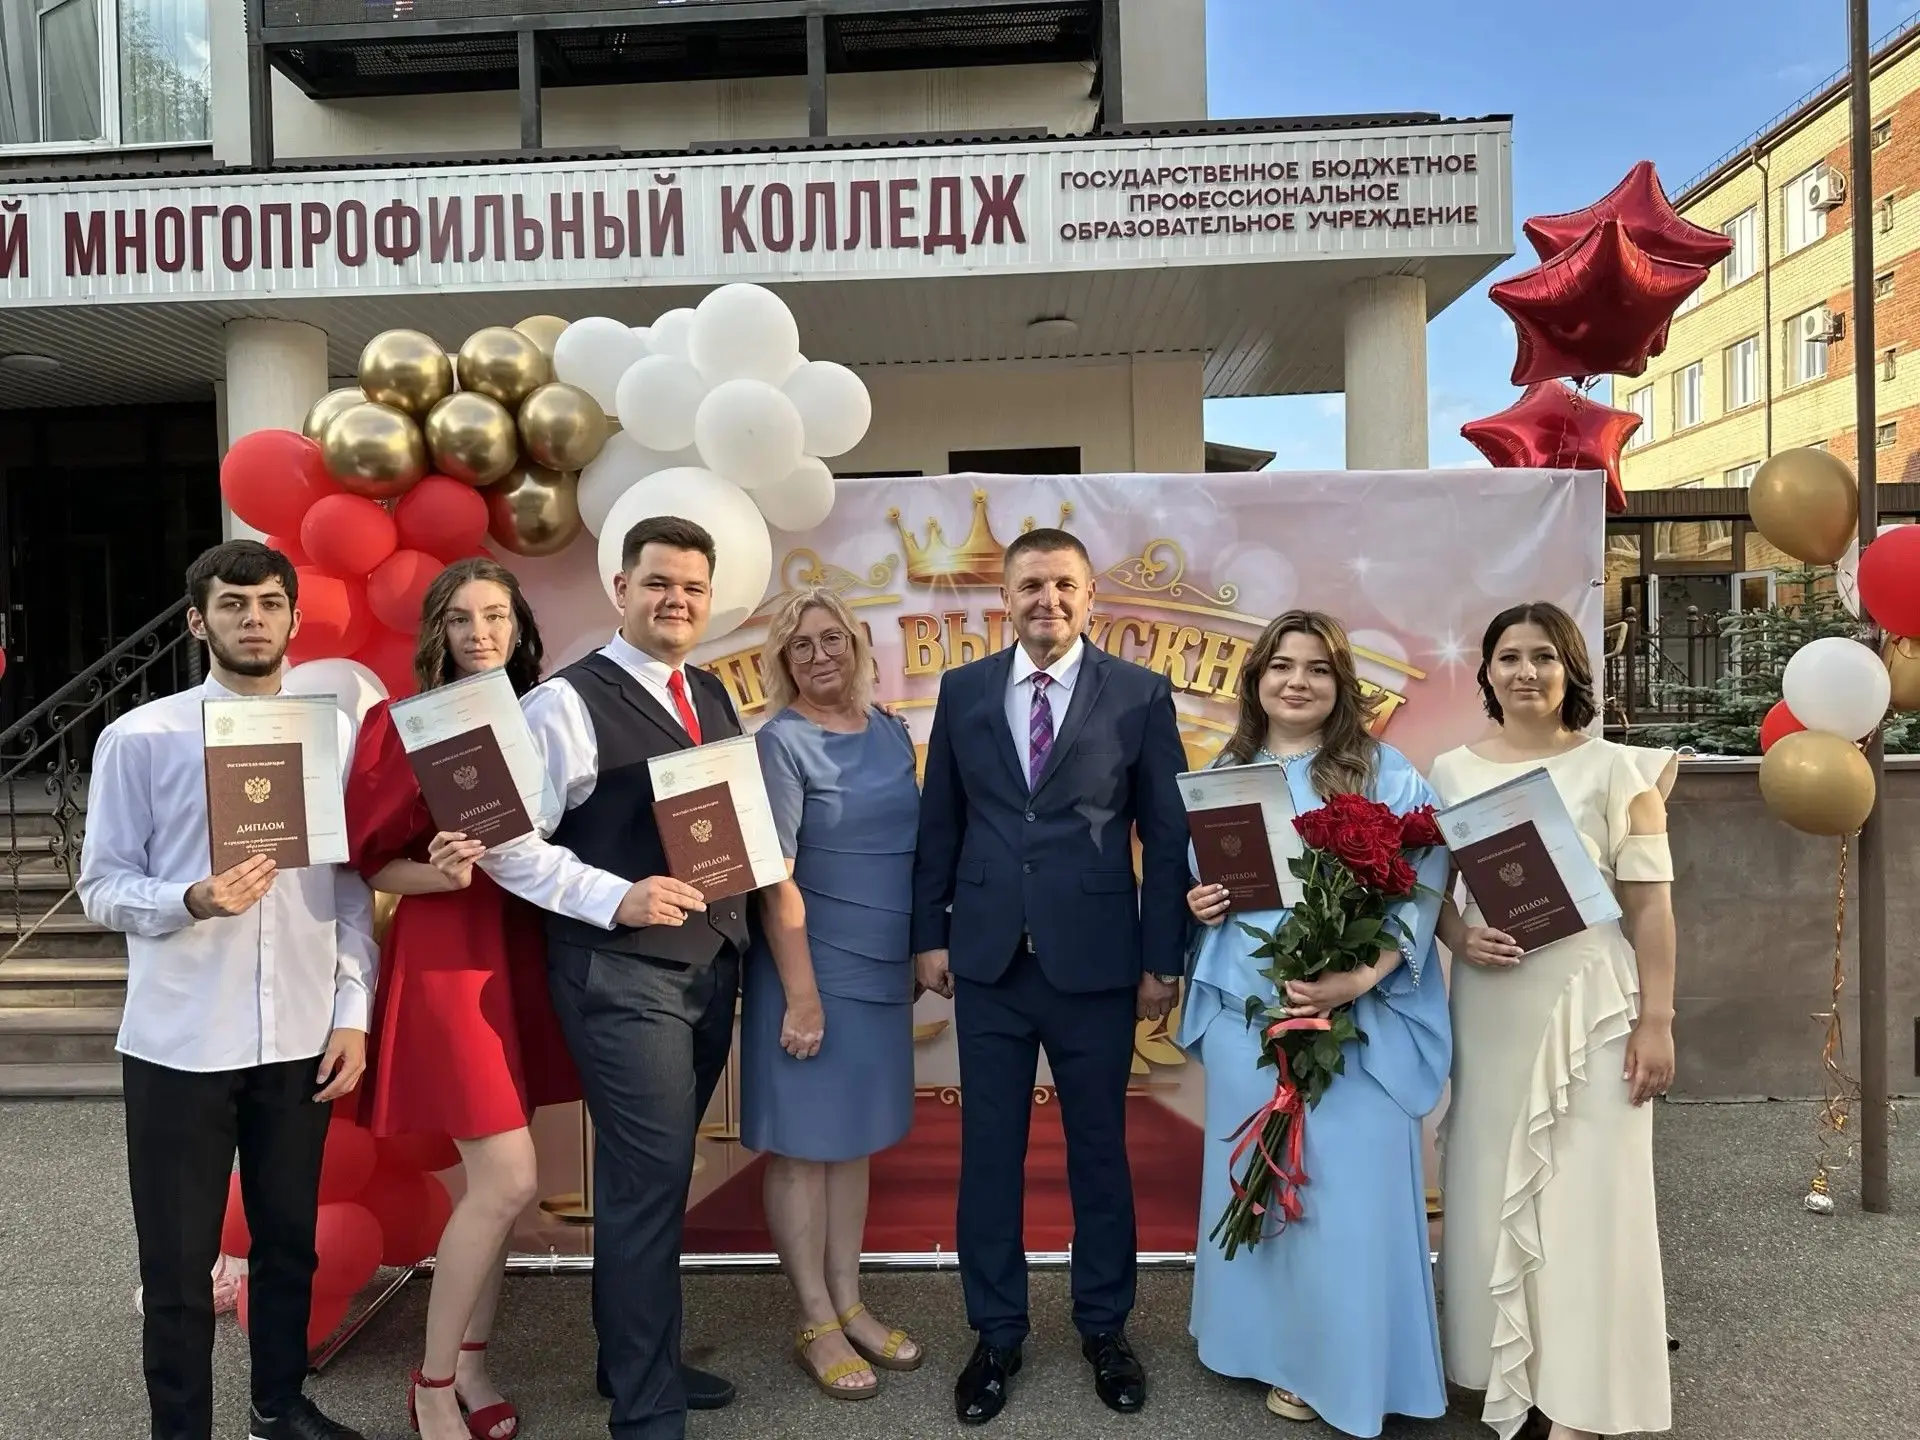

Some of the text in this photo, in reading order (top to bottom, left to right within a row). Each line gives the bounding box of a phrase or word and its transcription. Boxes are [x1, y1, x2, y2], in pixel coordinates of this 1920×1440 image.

[1060, 153, 1478, 191] ГОСУДАРСТВЕННОЕ БЮДЖЕТНОЕ
[1128, 182, 1400, 211] ПРОФЕССИОНАЛЬНОЕ
[65, 172, 687, 277] МНОГОПРОФИЛЬНЫЙ
[721, 174, 1026, 255] КОЛЛЕДЖ
[1060, 205, 1478, 241] ОБРАЗОВАТЕЛЬНОЕ УЧРЕЖДЕНИЕ
[461, 799, 502, 821] ДИПЛОМ
[236, 821, 285, 834] ДИПЛОМ
[692, 854, 731, 873] ДИПЛОМ
[1508, 896, 1550, 919] ДИПЛОМ
